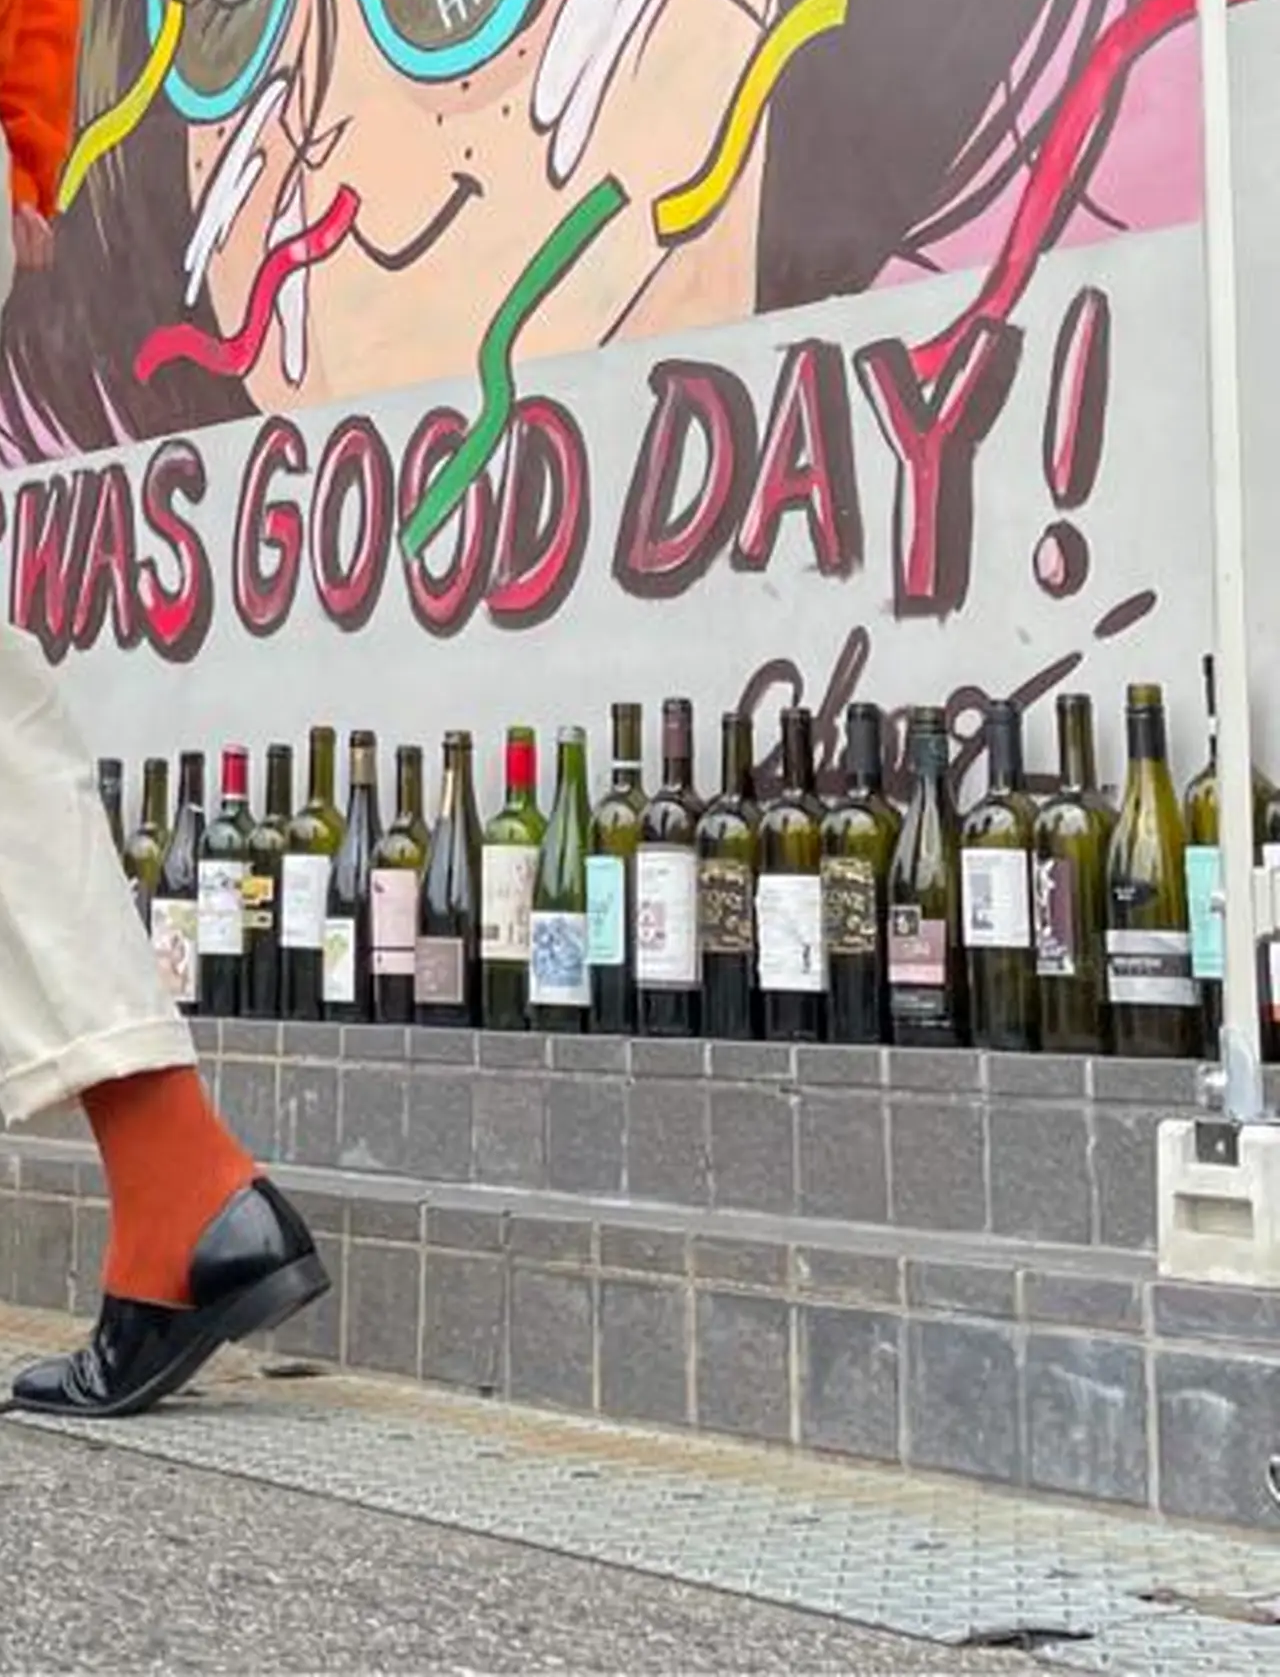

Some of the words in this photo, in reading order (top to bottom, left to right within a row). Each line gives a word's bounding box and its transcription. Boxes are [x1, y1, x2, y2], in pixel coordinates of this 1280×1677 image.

[10, 439, 214, 665] WAS
[233, 398, 590, 636] GOOD
[611, 286, 1112, 618] DAY!
